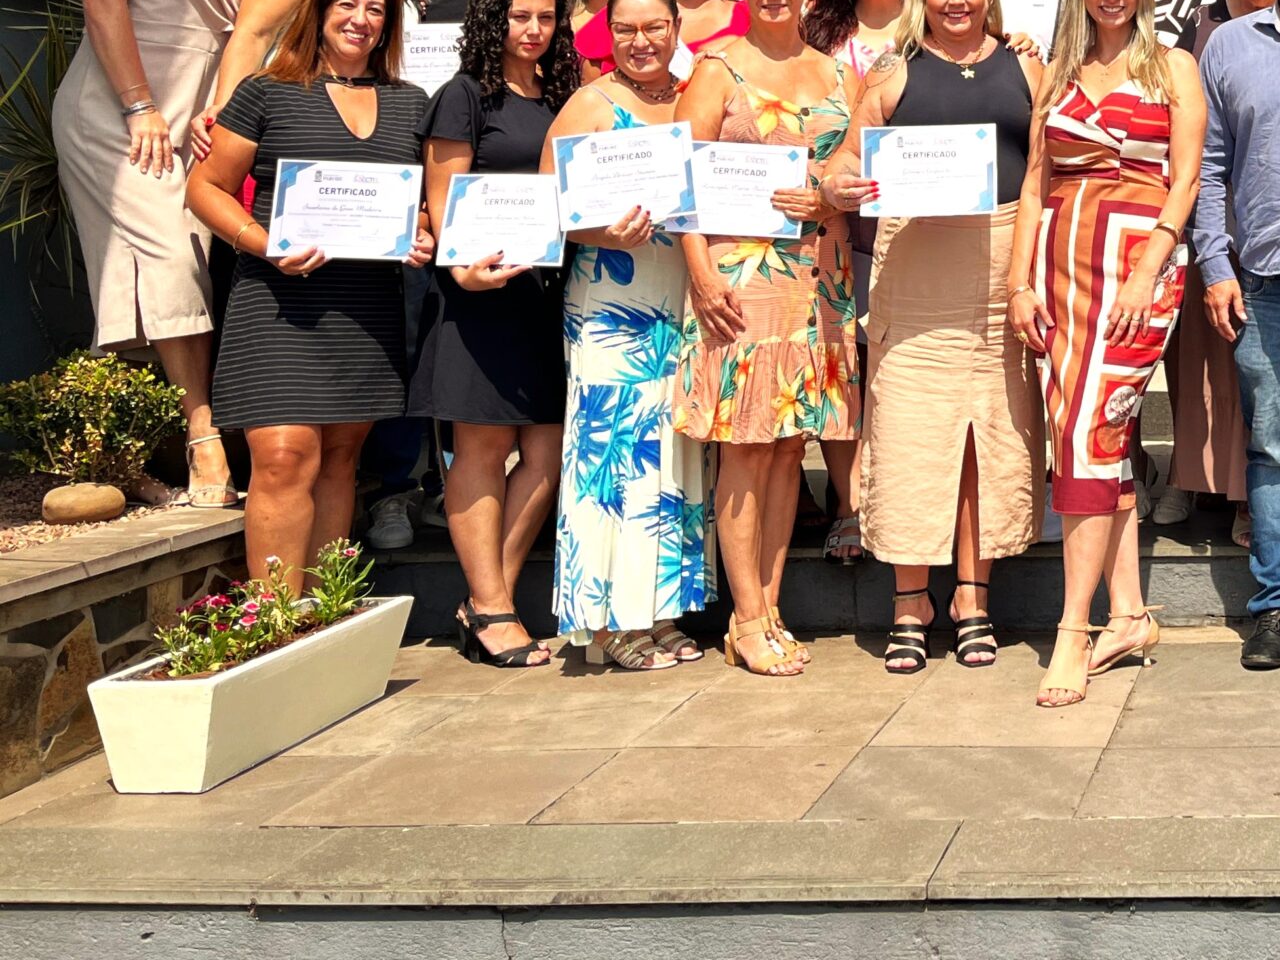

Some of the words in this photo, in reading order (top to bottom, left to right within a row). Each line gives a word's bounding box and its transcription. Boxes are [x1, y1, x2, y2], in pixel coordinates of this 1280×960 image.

[596, 150, 653, 164] CERTIFICADO
[902, 151, 957, 160] CERTIFICADO
[713, 167, 767, 177] CERTIFICADO
[318, 187, 378, 197] CERTIFICADO
[484, 198, 535, 206] CERTIFICADO
